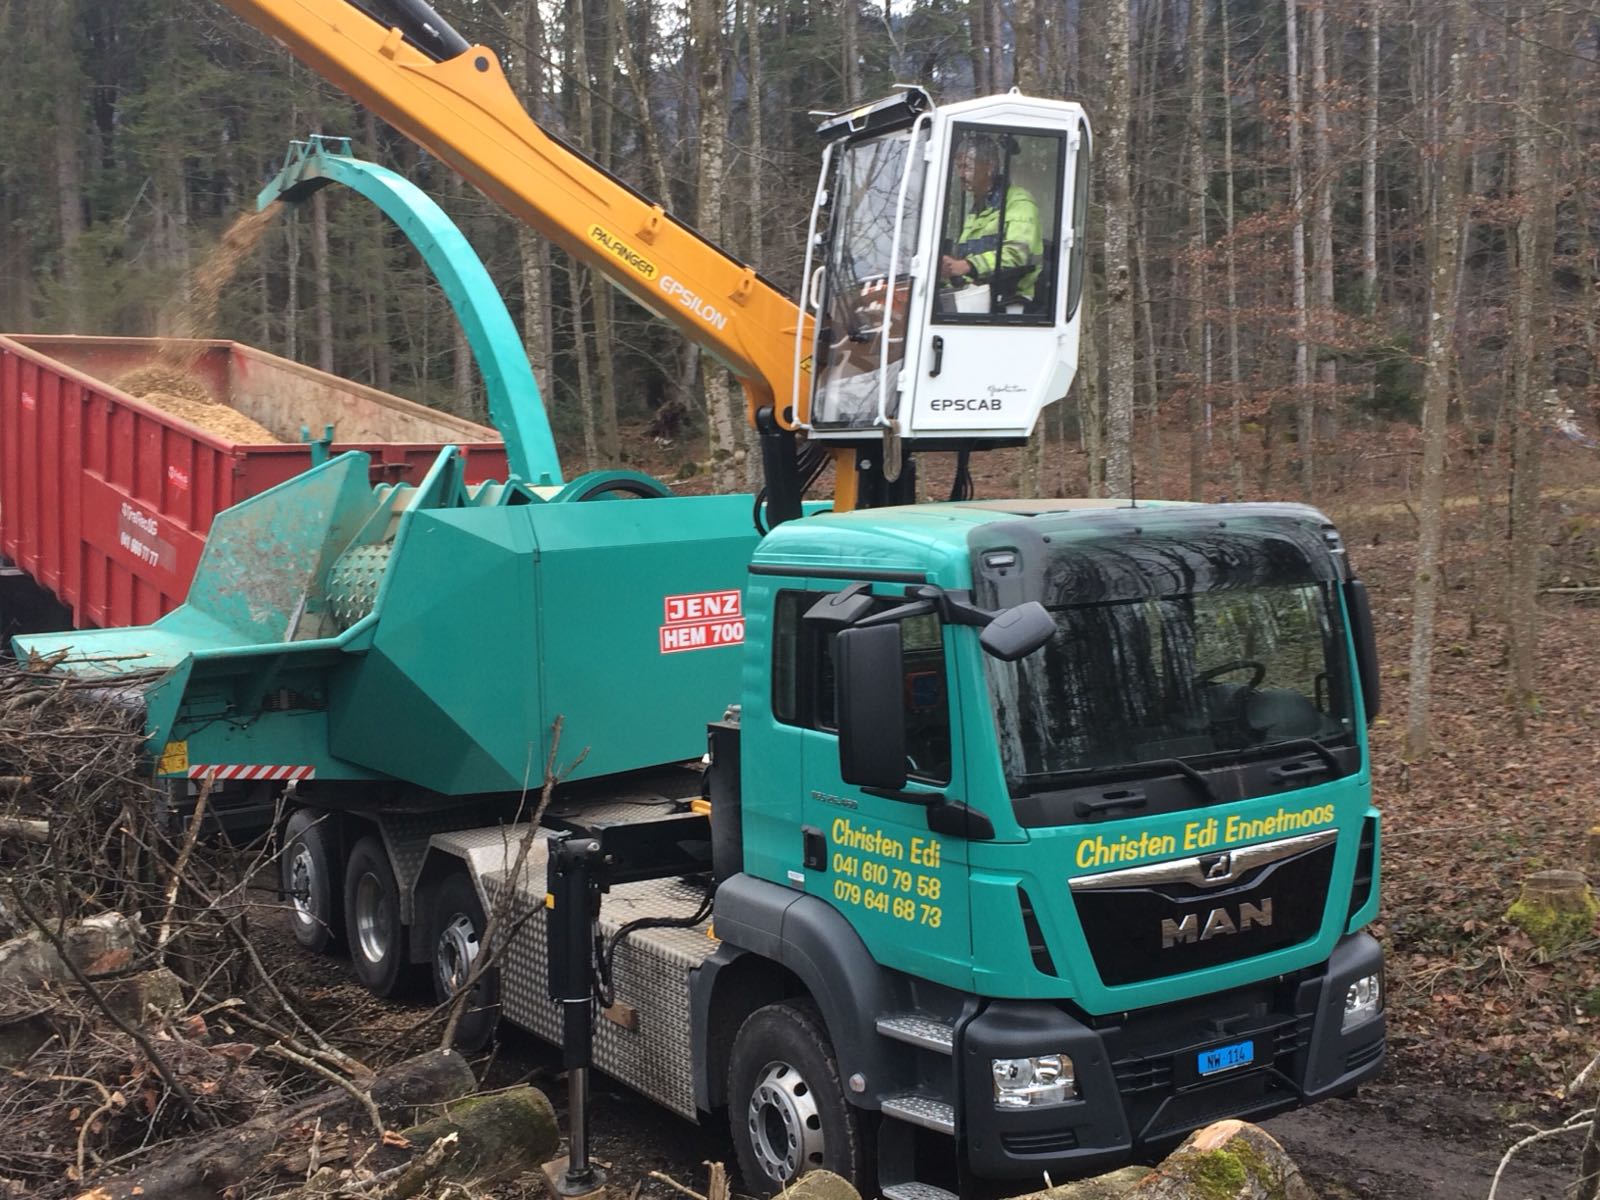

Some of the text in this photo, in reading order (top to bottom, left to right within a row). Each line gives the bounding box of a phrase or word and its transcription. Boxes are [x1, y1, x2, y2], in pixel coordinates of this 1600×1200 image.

[591, 226, 655, 278] PALFINGER
[659, 275, 728, 331] EPSILON
[930, 399, 1002, 411] EPSCAB
[669, 594, 738, 620] JENZ
[664, 622, 745, 649] HEM 700
[832, 818, 942, 869] Christen Edi
[1076, 803, 1336, 868] Christen Edi Ennetmoos
[832, 853, 859, 878] 041
[862, 861, 889, 886] 610
[892, 868, 913, 892] 79
[917, 875, 942, 900] 58
[834, 880, 943, 928] 079 641 68 73
[1161, 897, 1273, 949] MAN
